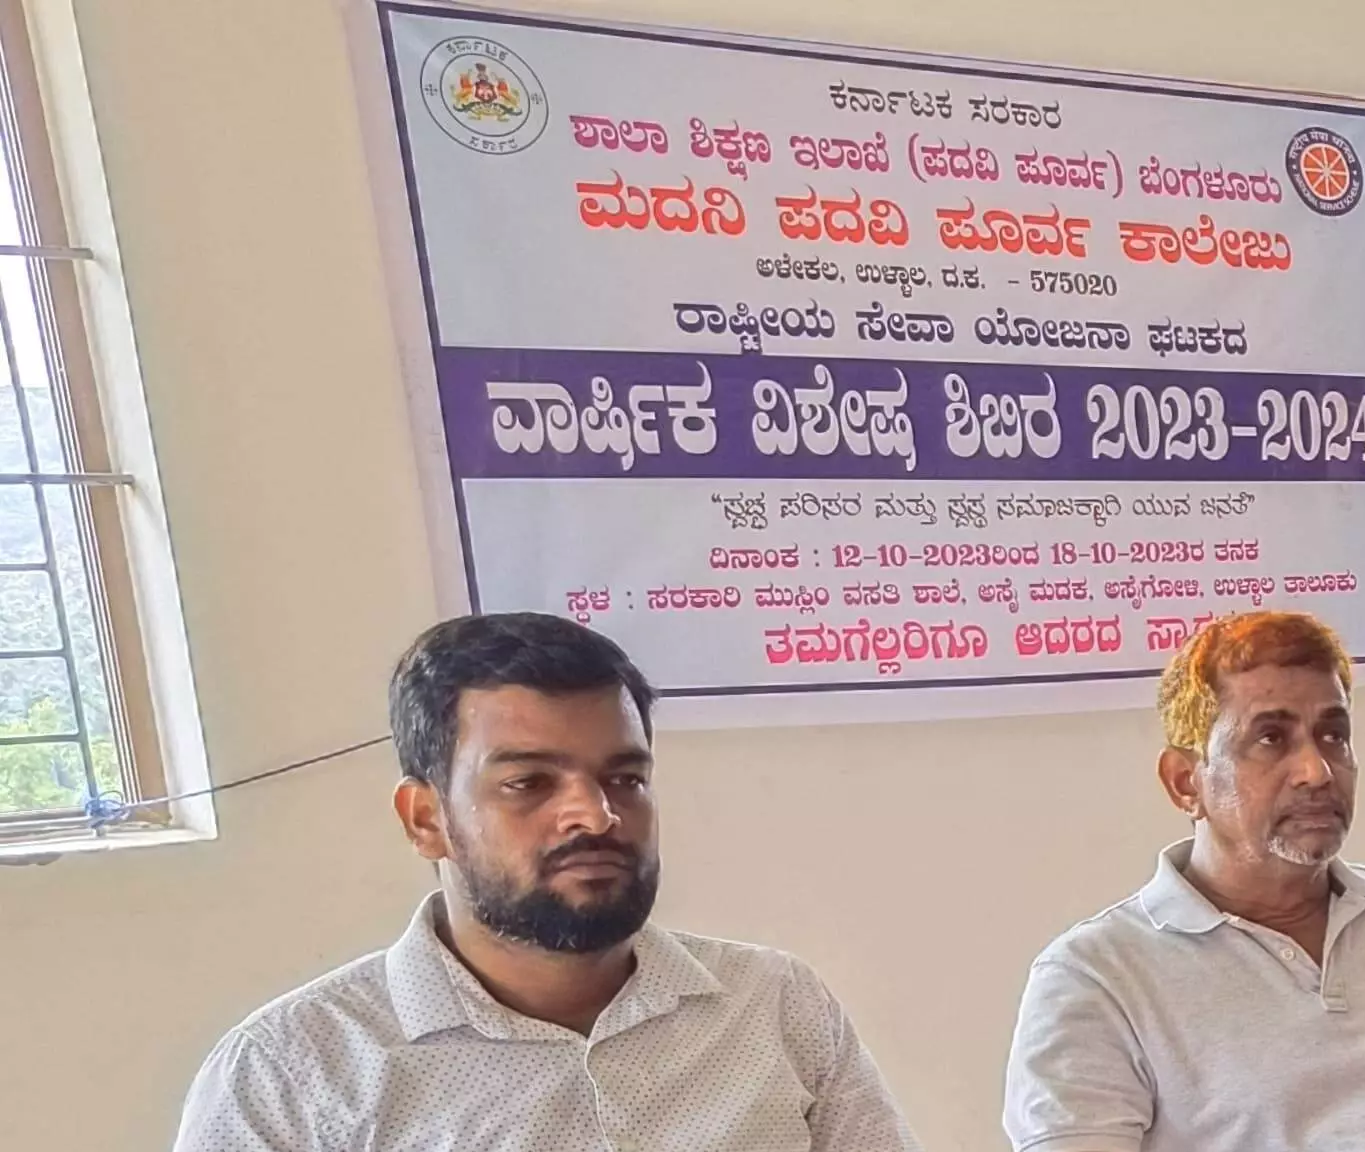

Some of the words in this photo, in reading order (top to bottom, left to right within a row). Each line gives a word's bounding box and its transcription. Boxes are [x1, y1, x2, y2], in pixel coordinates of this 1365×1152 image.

[829, 80, 953, 119] ಕರ್ನಾಟಕ
[970, 93, 1062, 129] ಸರಕಾರ
[569, 114, 669, 155] ಶಾಲಾ
[690, 117, 772, 181] ಶಿಕ್ಷಣ
[790, 132, 890, 172] ಇಲಾಖೆ
[908, 133, 1000, 183] (ಪದವಿ
[1014, 148, 1124, 199] ಪೂರ್ವ)
[1139, 155, 1283, 203] ಬೆಂಗಳೂರು
[574, 168, 747, 236] ಮದನಿ
[774, 183, 910, 249] ಪದವಿ
[936, 196, 1092, 259] ಪೂರ್ವ
[1118, 214, 1292, 272] ಕಾಲೇಜು
[756, 253, 845, 284] ಅಳೇಕಲ,
[856, 263, 932, 298] ಉಳ್ಳಾಲ,
[941, 264, 986, 290] ದ.ಕ.
[1030, 270, 1117, 297] 575020
[855, 301, 955, 343] ಸೇವಾ
[974, 307, 1131, 351] ಯೋಜನಾ
[1147, 315, 1248, 358] ಘಟಕದ
[486, 360, 717, 471] ವಾರ್ಷಿಕ
[752, 363, 917, 472] ವಿಶೇಷ
[944, 371, 1062, 459] ಶಿಬಿರ
[780, 492, 862, 520] ಪರಿಸರ
[875, 492, 938, 525] ಮತ್ತು
[1132, 493, 1191, 517] ಯುವ
[709, 541, 800, 569] ದಿನಾಂಕ
[832, 541, 1039, 569] 12-10-2023ರಿಂದ
[1051, 540, 1204, 565] 18-10-2023ರ
[1215, 539, 1259, 561] ತನಕ
[566, 584, 611, 626] ಸ್ಥಳ
[647, 583, 741, 609] ಸರಕಾರಿ
[843, 580, 900, 606] ವಸತಿ
[1214, 574, 1275, 606] ಉಳ್ಳಾಲ
[1283, 569, 1357, 594] ತಾಲೂಕು
[764, 618, 988, 676] ತಮಗೆಲ್ಲರಿಗೂ
[1014, 613, 1122, 657] ಆದರದ
